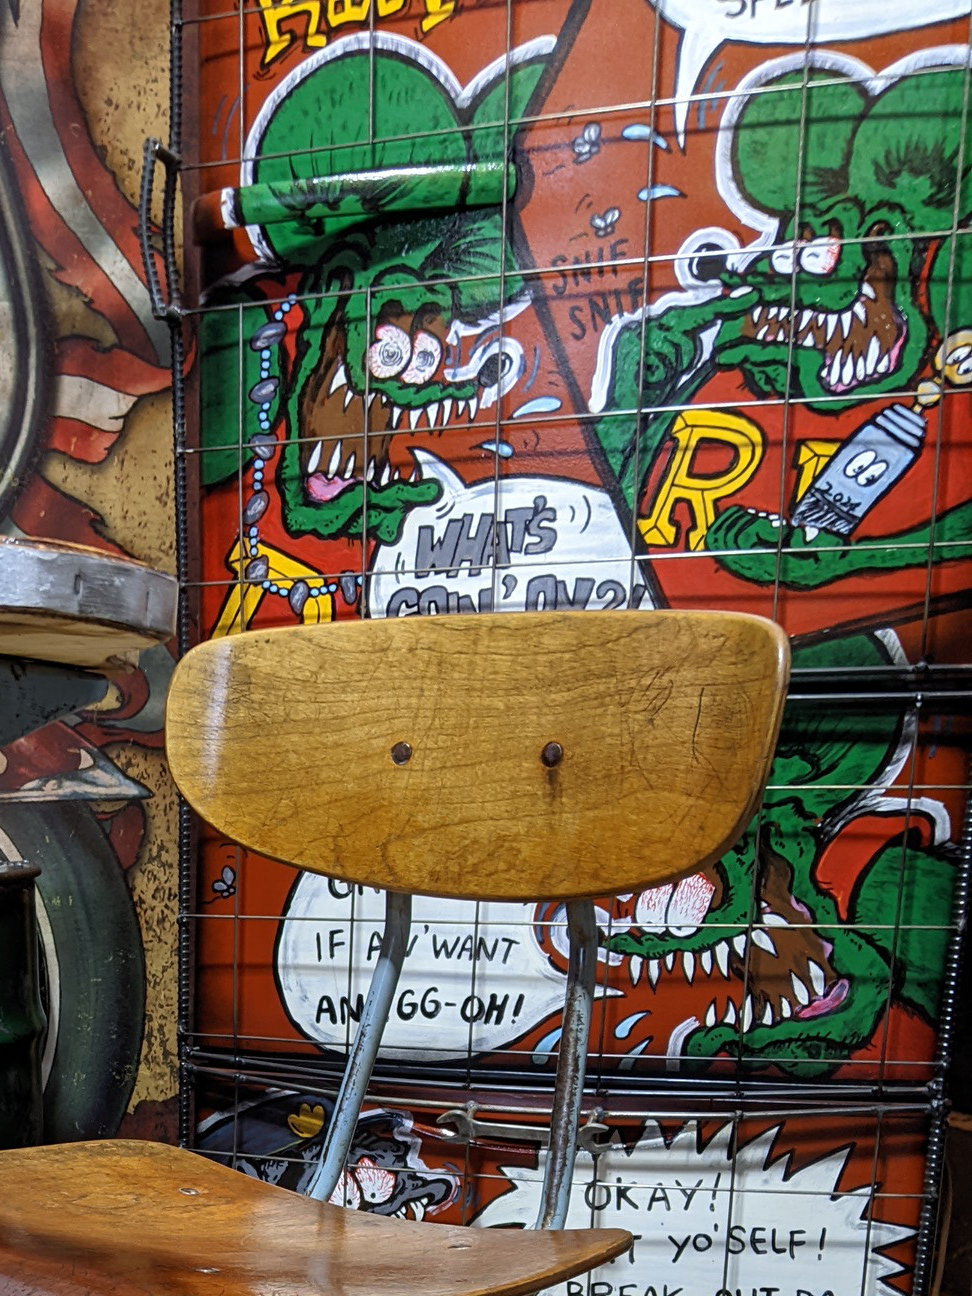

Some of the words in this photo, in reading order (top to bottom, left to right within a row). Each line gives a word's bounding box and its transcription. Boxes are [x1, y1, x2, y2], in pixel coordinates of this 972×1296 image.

[550, 238, 630, 297] SNIF
[415, 495, 558, 579] WHAT'S
[316, 928, 346, 962] IF
[584, 1171, 722, 1212] OKAY!
